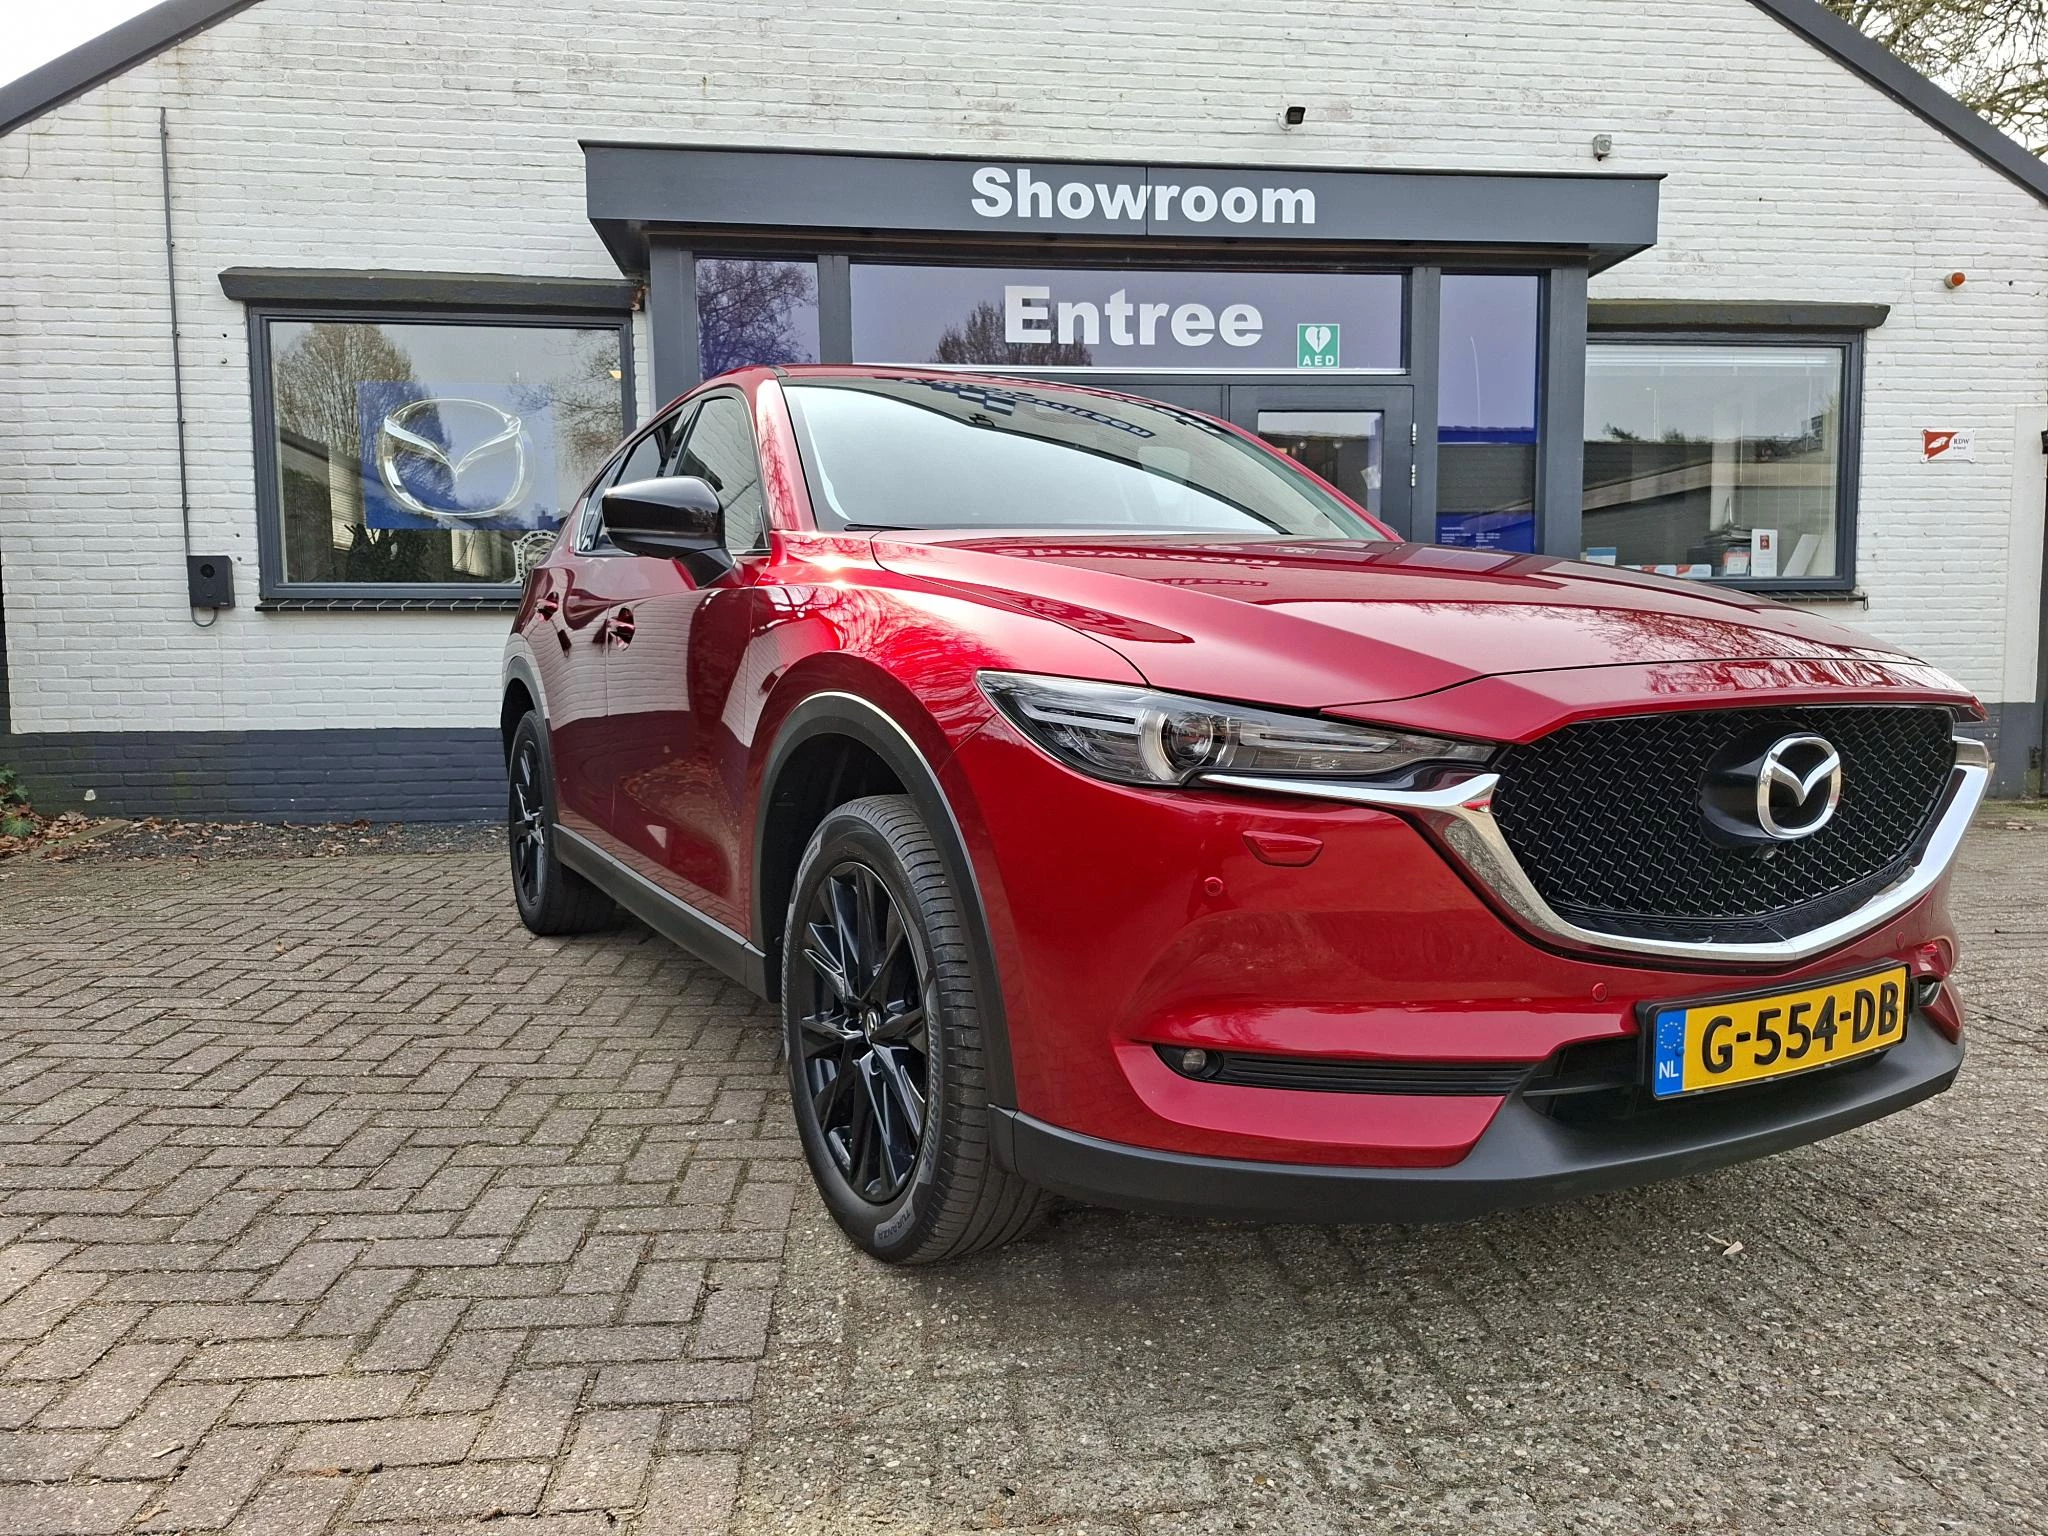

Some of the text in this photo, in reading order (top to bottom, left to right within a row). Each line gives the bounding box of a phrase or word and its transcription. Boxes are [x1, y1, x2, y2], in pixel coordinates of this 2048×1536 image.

[971, 167, 1316, 224] Showroom
[1004, 285, 1263, 347] Entree
[1302, 355, 1334, 366] AED
[1701, 981, 1899, 1074] G-554-DB
[923, 1012, 941, 1171] BRIDGESTONE
[1658, 1061, 1680, 1080] NL
[877, 1209, 911, 1240] TURANZA
